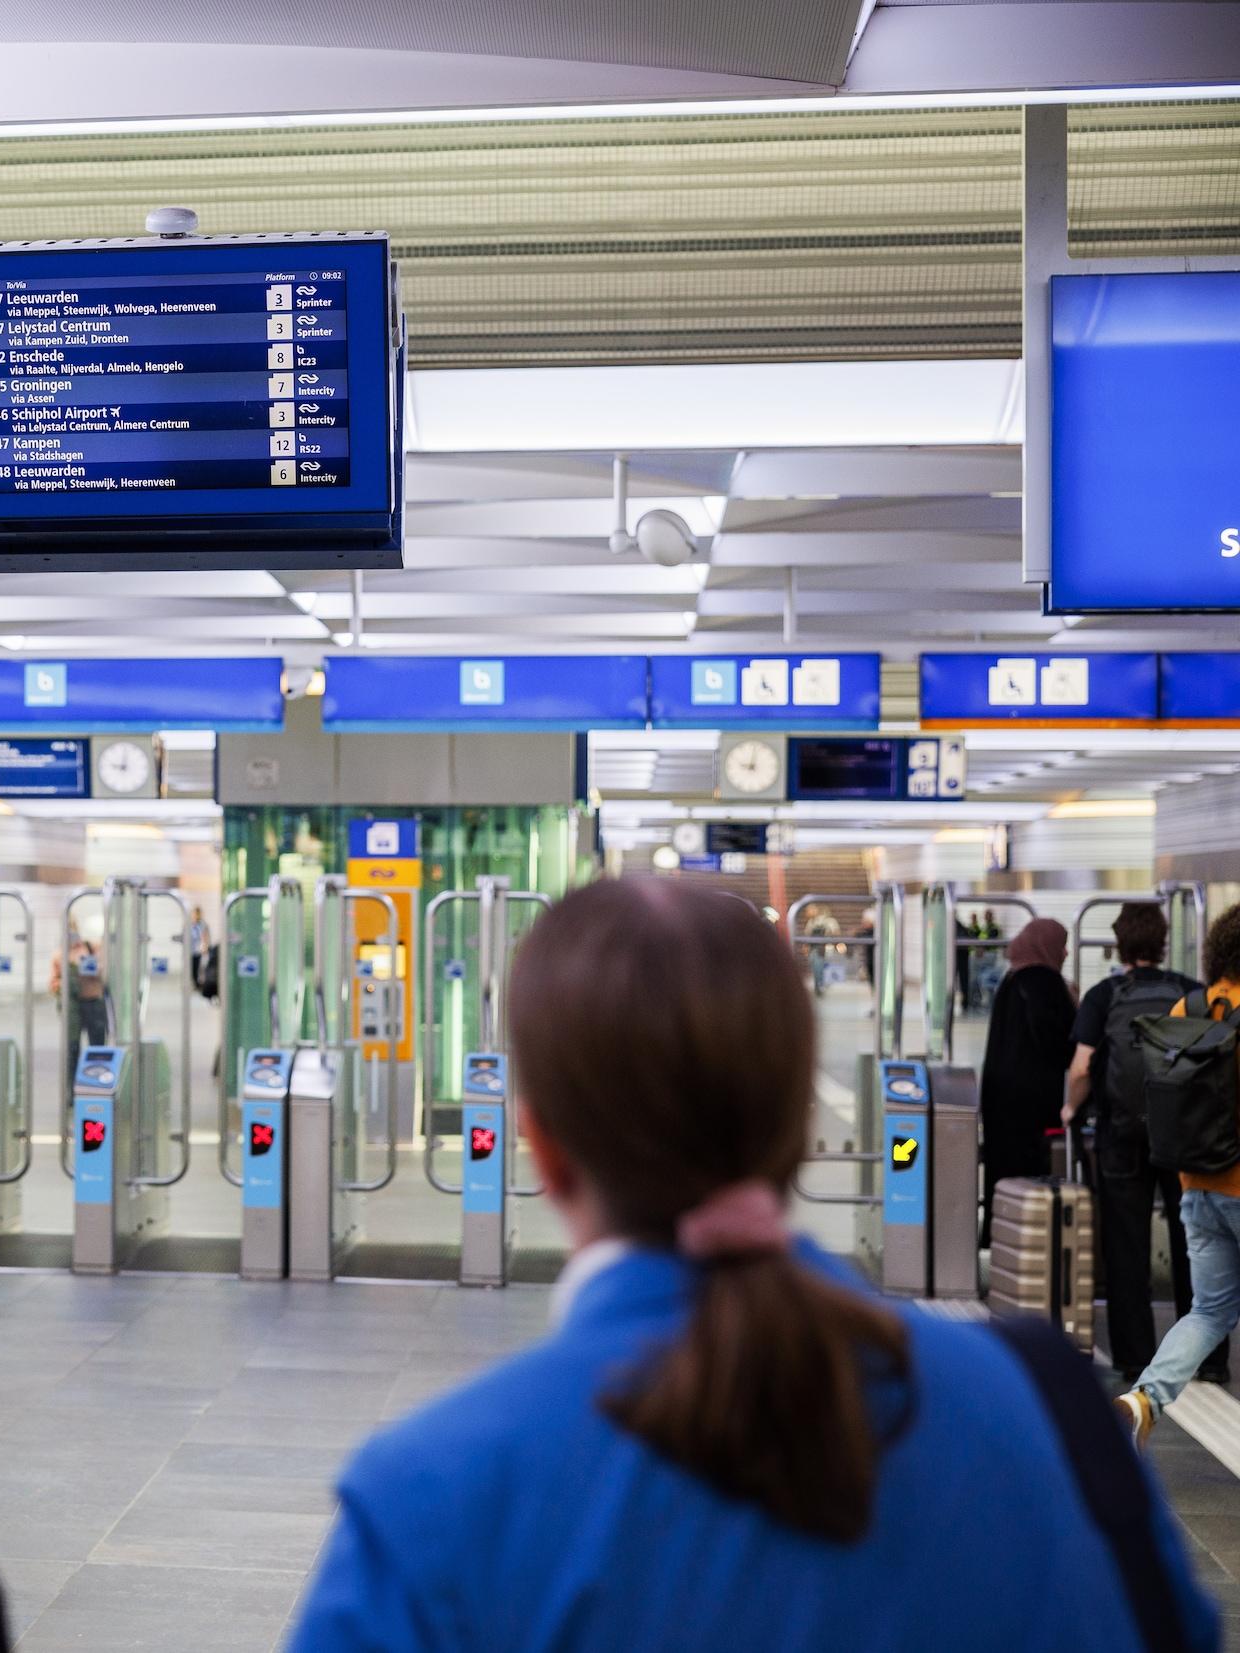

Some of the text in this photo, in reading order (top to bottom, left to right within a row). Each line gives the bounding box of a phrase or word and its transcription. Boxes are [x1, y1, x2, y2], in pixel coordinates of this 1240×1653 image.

[6, 291, 79, 305] Leeuwarden
[8, 320, 57, 337] Lelystad
[60, 320, 111, 332] Centrum
[9, 349, 64, 363] Enschede
[10, 378, 72, 394] Groningen
[11, 406, 61, 423] Schiphol
[64, 406, 108, 422] Airport
[13, 437, 61, 451] Kampen
[14, 463, 86, 478] Leeuwarden
